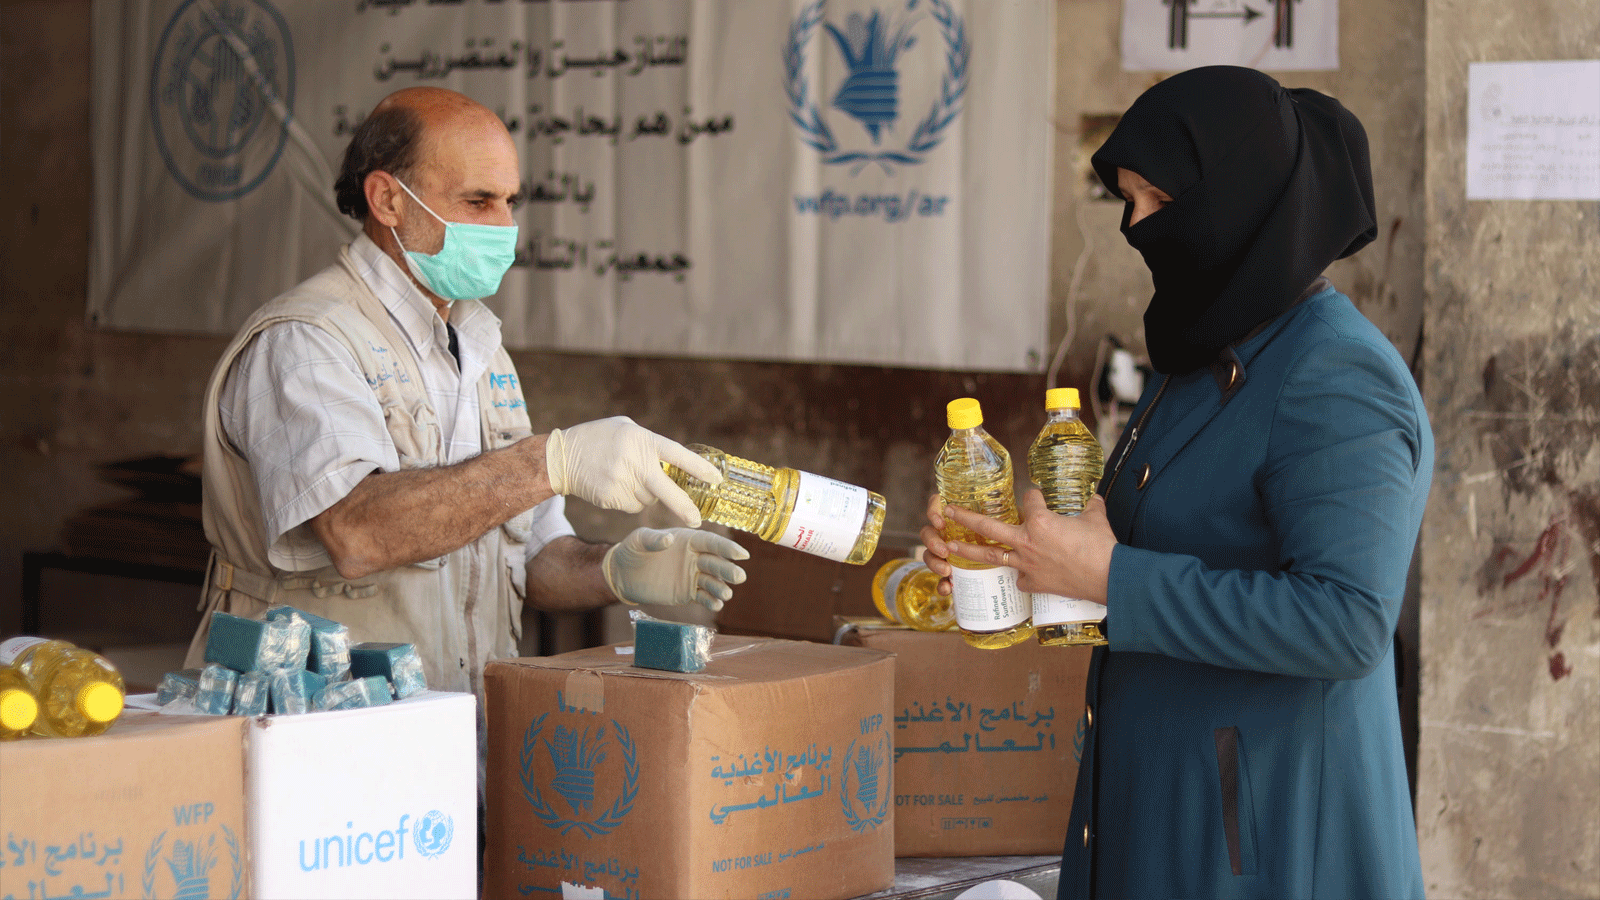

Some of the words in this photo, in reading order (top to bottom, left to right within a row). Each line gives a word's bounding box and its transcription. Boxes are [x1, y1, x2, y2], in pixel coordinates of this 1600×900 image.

[526, 104, 622, 145] بحاجة
[630, 111, 669, 141] هم
[677, 103, 733, 147] ممن
[794, 190, 949, 223] wfp.org/ar
[595, 241, 690, 281] جمعية
[991, 595, 1001, 620] Refined
[1000, 586, 1009, 618] Sunflower
[860, 713, 883, 736] WFP
[894, 695, 971, 729] الأغذي
[976, 700, 1055, 732] برنامج
[711, 744, 782, 787] الأغذية
[785, 742, 832, 781] برنامج
[173, 802, 214, 827] WFP
[709, 773, 831, 826] العالمي
[895, 794, 911, 807] OT
[912, 794, 935, 807] FOR
[938, 794, 965, 806] SALE
[44, 831, 123, 876] برنامج
[300, 814, 409, 872] unicef
[517, 845, 579, 871] الأغذية
[584, 858, 640, 884] برنامج
[712, 859, 732, 873] NOT
[735, 855, 752, 870] FOR
[754, 852, 772, 867] SALE
